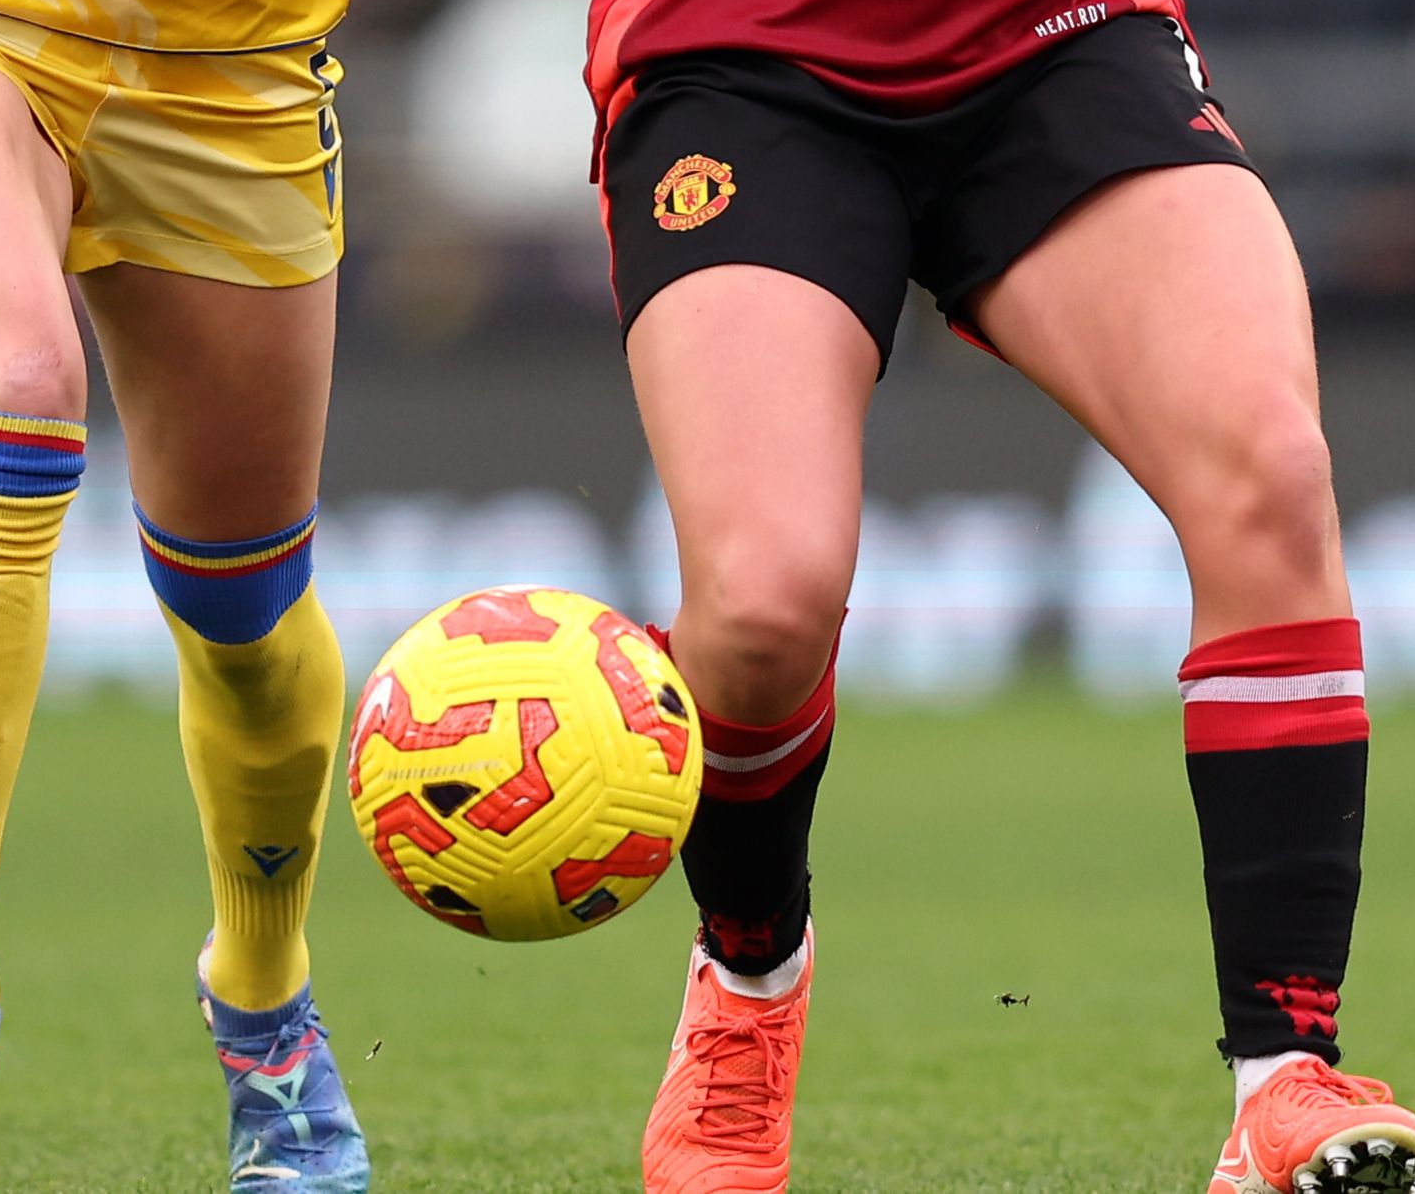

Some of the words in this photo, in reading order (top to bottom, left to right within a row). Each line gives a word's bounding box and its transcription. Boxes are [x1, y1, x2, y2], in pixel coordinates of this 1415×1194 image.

[1034, 2, 1107, 38] HEAT.RDY
[658, 159, 726, 197] MANCHESTER
[669, 206, 717, 227] UNITED
